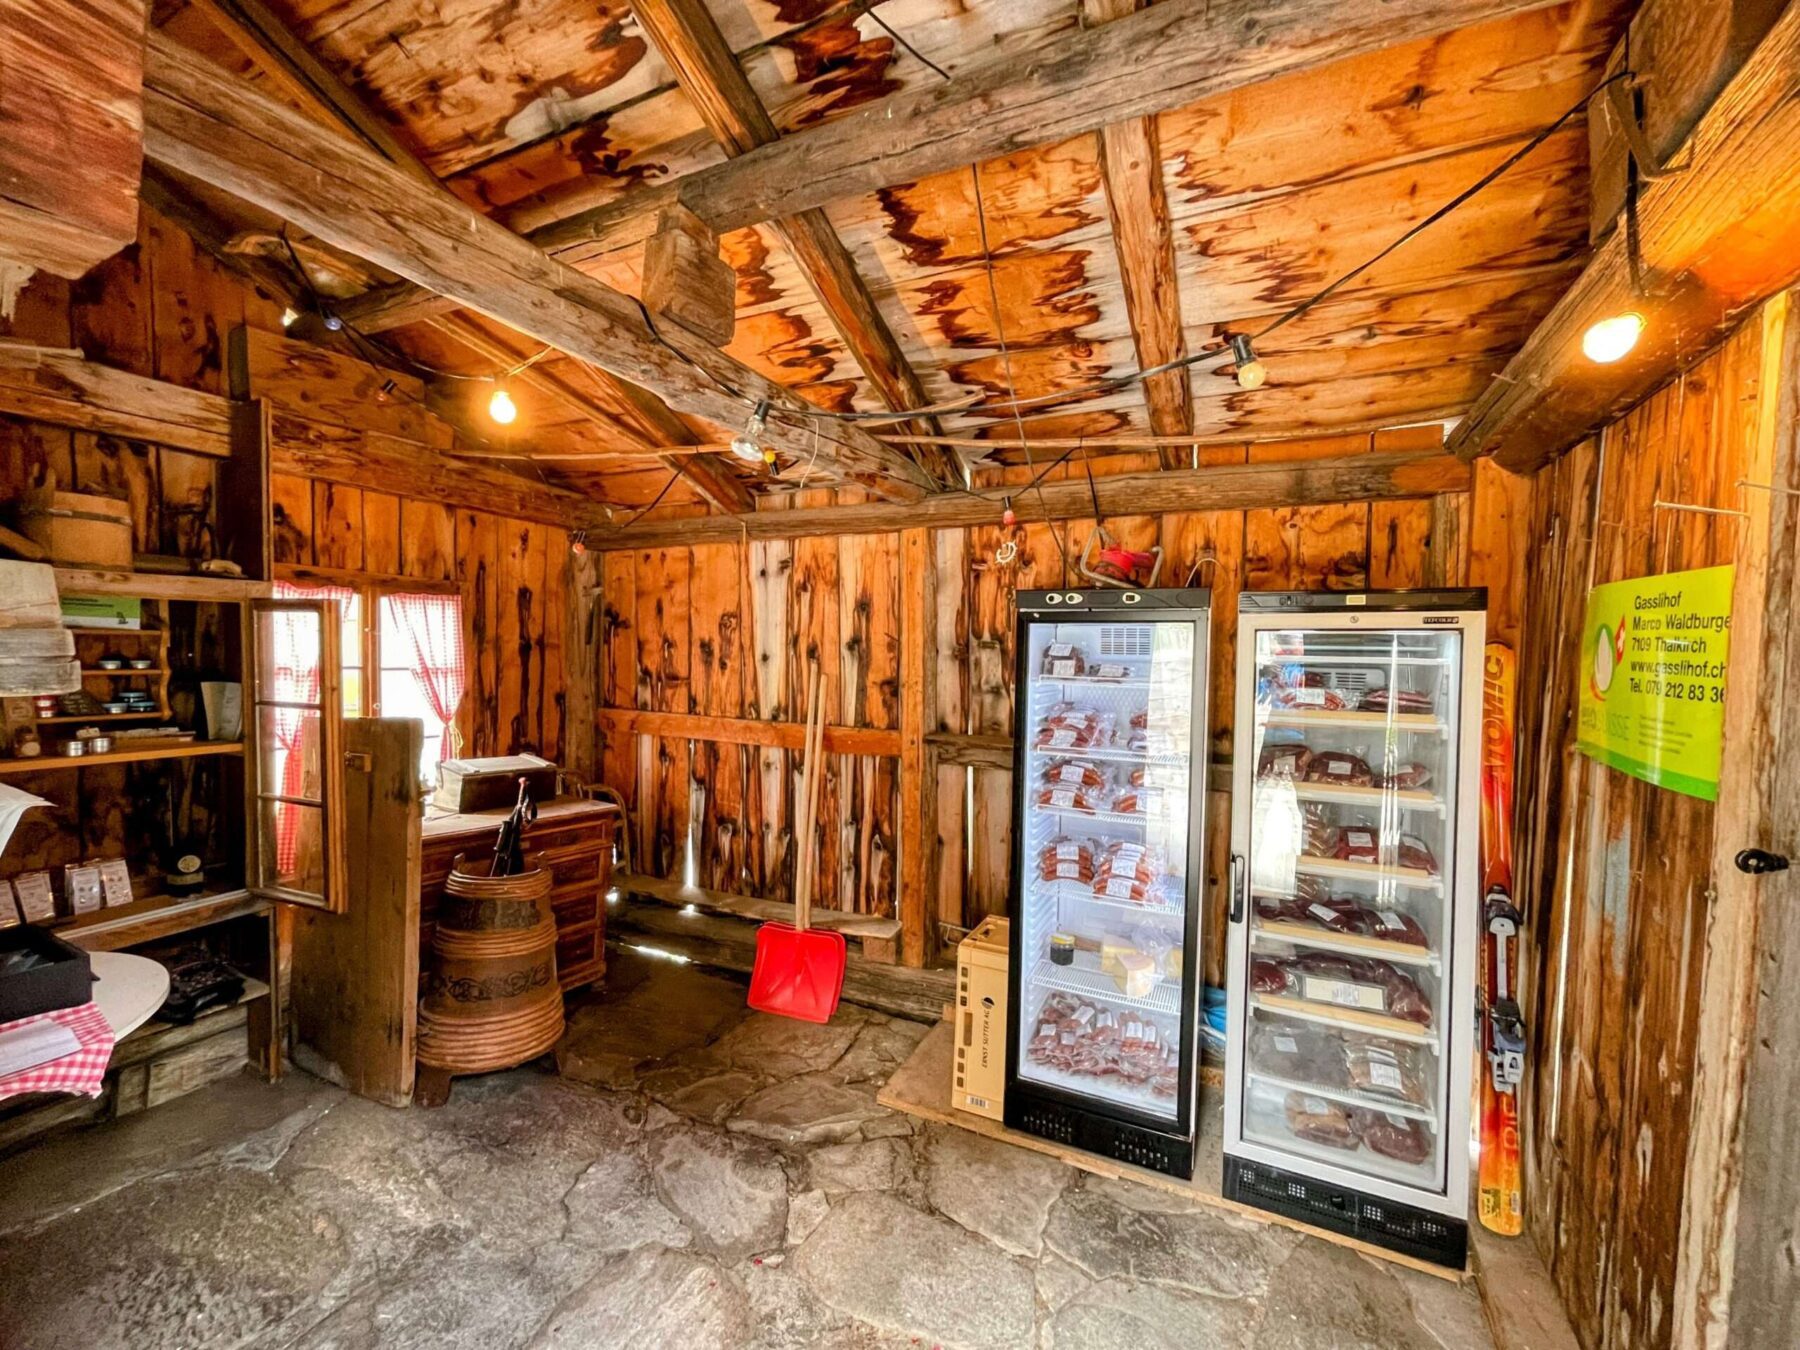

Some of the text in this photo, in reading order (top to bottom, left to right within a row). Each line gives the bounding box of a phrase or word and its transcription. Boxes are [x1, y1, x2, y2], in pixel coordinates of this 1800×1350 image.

[1634, 591, 1682, 610] Gasslihof
[1632, 616, 1662, 631] Marco
[1632, 637, 1707, 653] 7109 Thalkirch
[1629, 677, 1643, 693] Tel.
[1665, 682, 1684, 699] 212
[1688, 684, 1705, 702] 83
